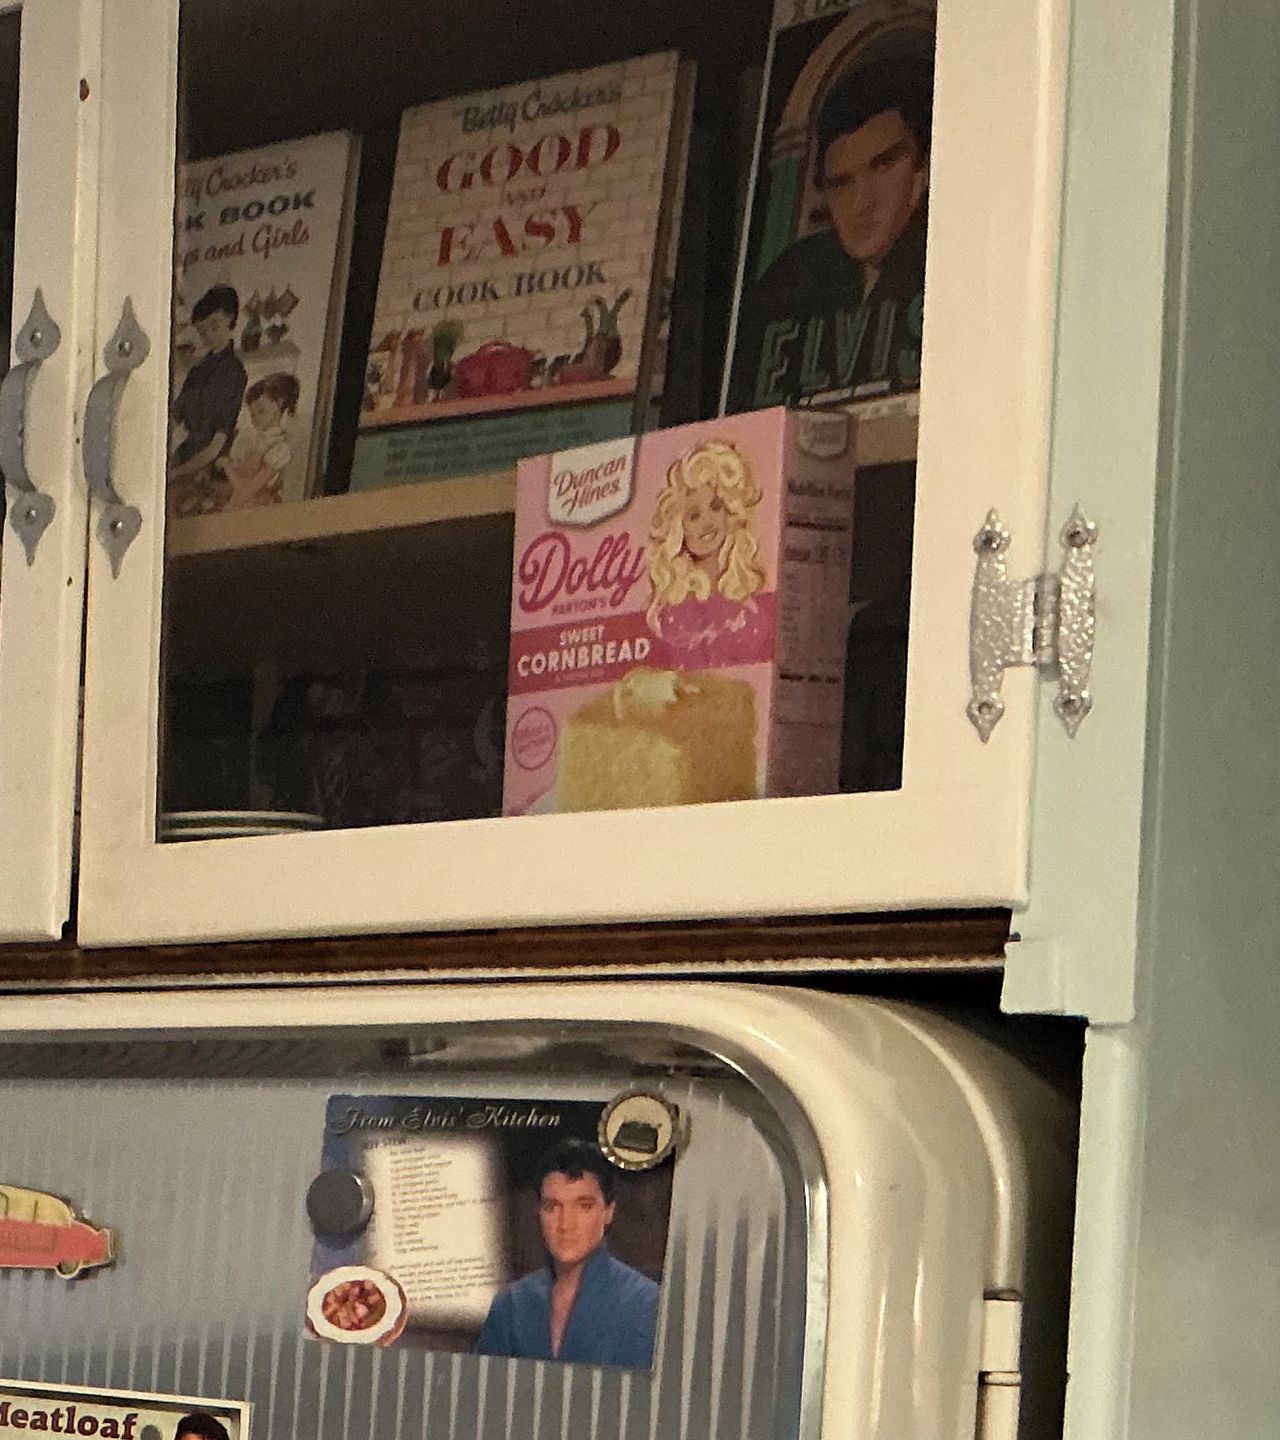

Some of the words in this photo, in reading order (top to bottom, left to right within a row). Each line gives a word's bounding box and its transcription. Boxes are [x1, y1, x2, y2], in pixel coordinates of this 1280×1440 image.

[462, 101, 517, 134] Betty
[436, 124, 620, 192] GOOD
[219, 190, 316, 226] BOOK
[205, 232, 245, 261] and
[252, 218, 310, 259] Girls
[436, 203, 598, 267] EASY
[412, 280, 500, 311] COOK
[514, 262, 606, 297] BOOK
[554, 455, 629, 497] Duncan
[561, 478, 622, 514] Hines
[518, 531, 647, 614] Dolly
[559, 624, 604, 647] SWEET
[517, 638, 651, 677] CORNBREAD
[331, 1106, 395, 1135] From
[466, 1105, 561, 1129] Kitchen
